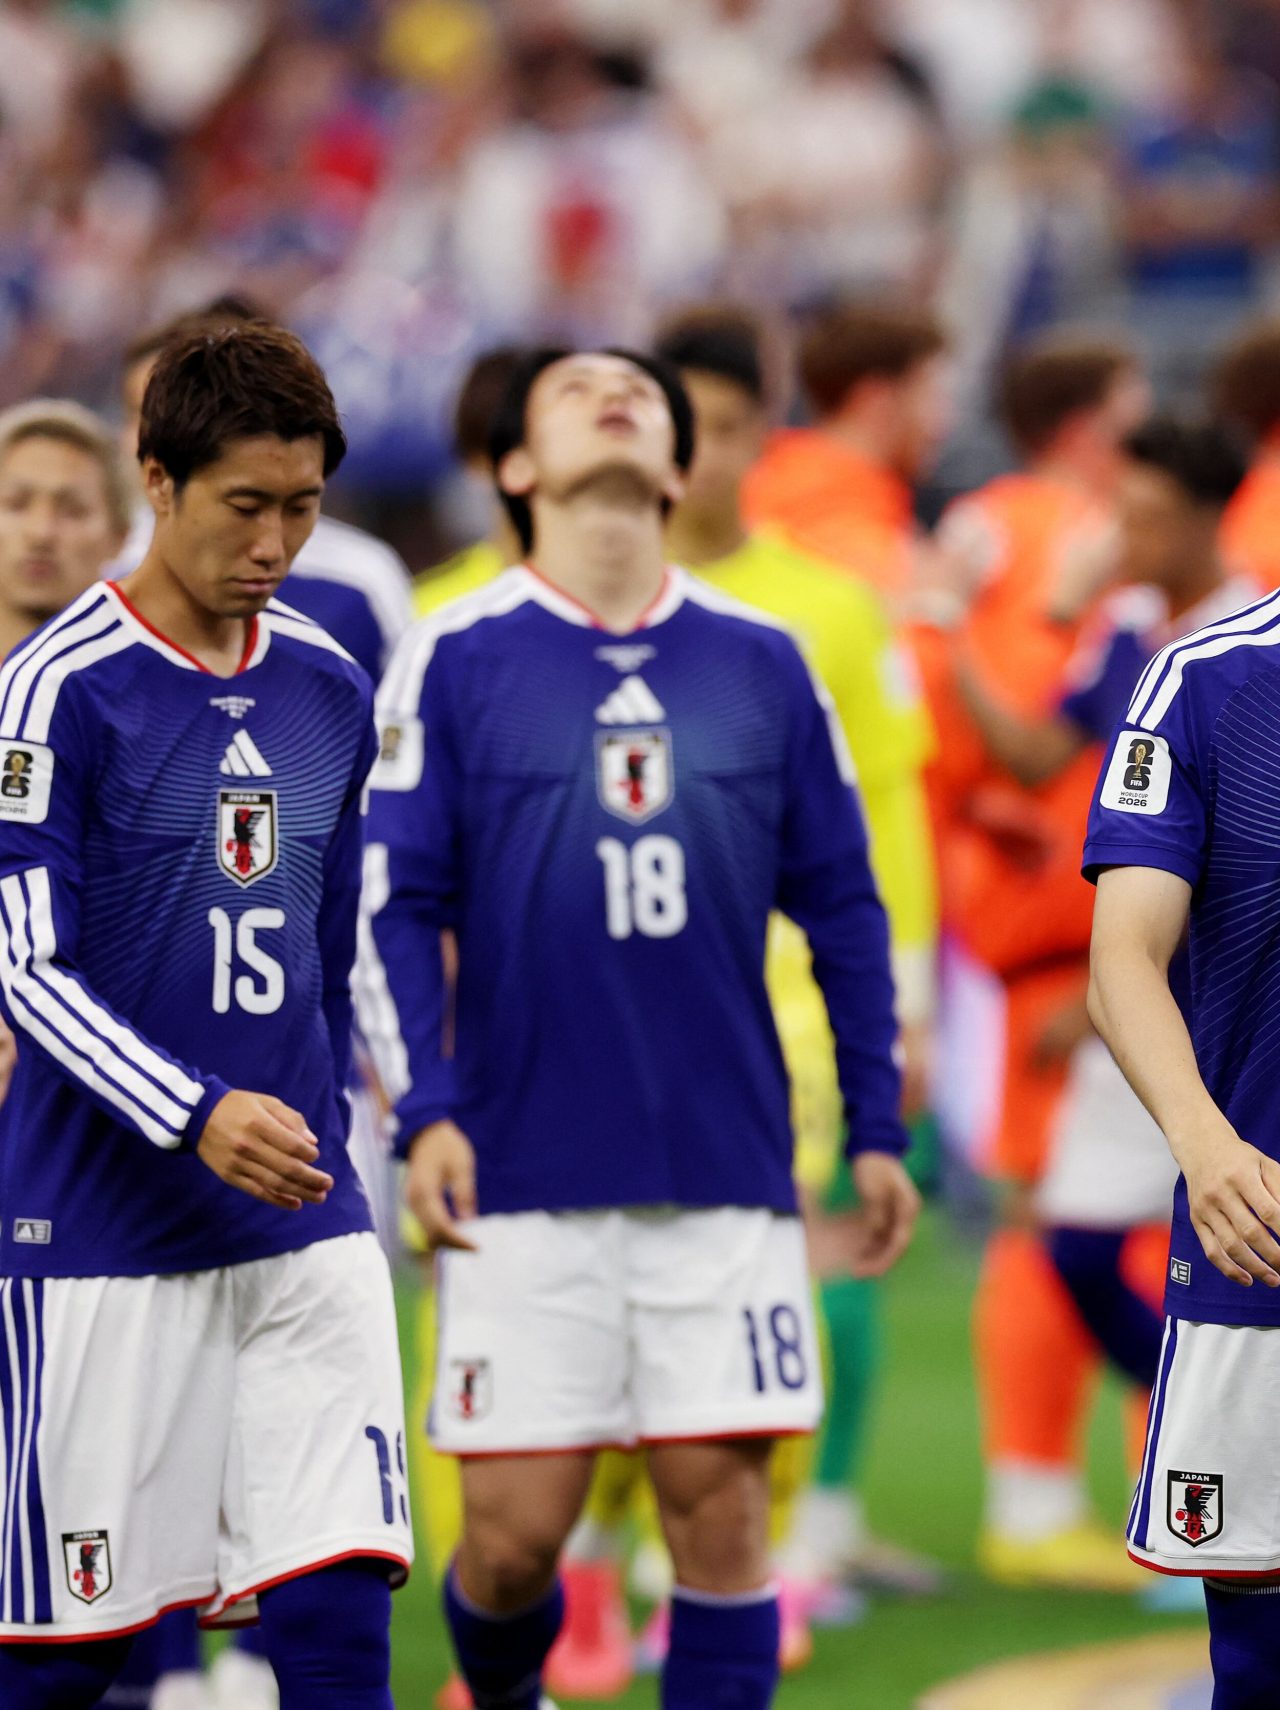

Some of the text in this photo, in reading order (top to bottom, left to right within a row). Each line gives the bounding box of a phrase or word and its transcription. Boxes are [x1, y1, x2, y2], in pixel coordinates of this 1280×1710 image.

[1130, 779, 1143, 787] FIFA
[1120, 791, 1138, 799] WORLD
[1118, 797, 1148, 807] 2026
[597, 835, 687, 938] 18
[208, 906, 286, 1015] 15
[744, 1305, 805, 1393] 18
[1179, 1473, 1210, 1482] JAPAN
[1180, 1522, 1207, 1535] JFA
